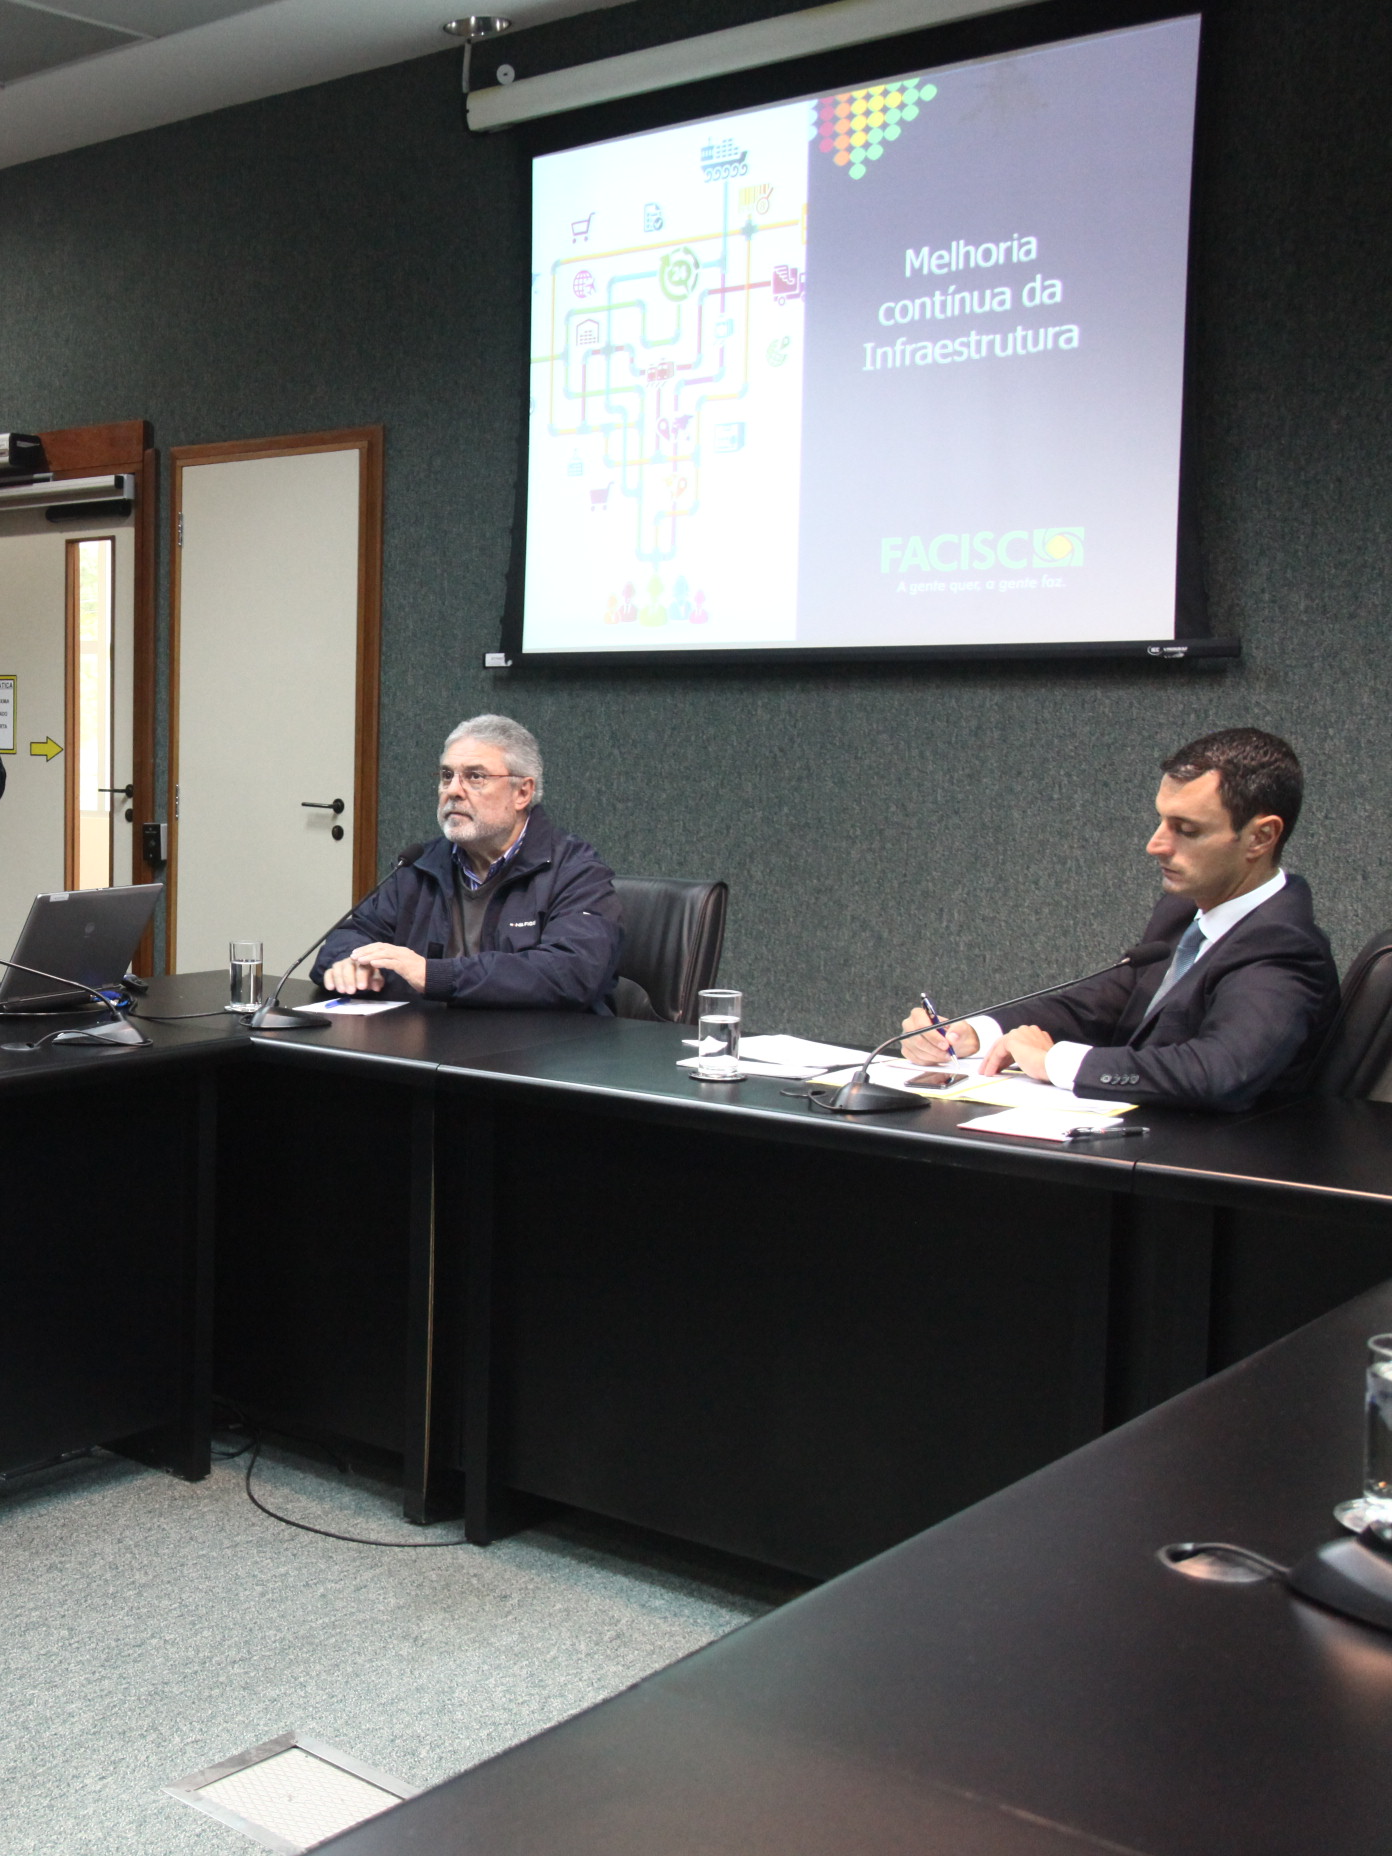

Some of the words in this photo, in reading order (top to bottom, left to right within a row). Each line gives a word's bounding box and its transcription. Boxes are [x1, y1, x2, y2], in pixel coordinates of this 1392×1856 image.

[904, 232, 1038, 278] Melhoria
[877, 284, 1012, 327] contínua
[1021, 273, 1063, 308] da
[862, 323, 1080, 371] Infraestrutura
[879, 529, 1029, 574] FACISC
[895, 581, 907, 593] A
[909, 580, 946, 595] gente
[985, 580, 996, 590] a
[998, 577, 1038, 593] gente
